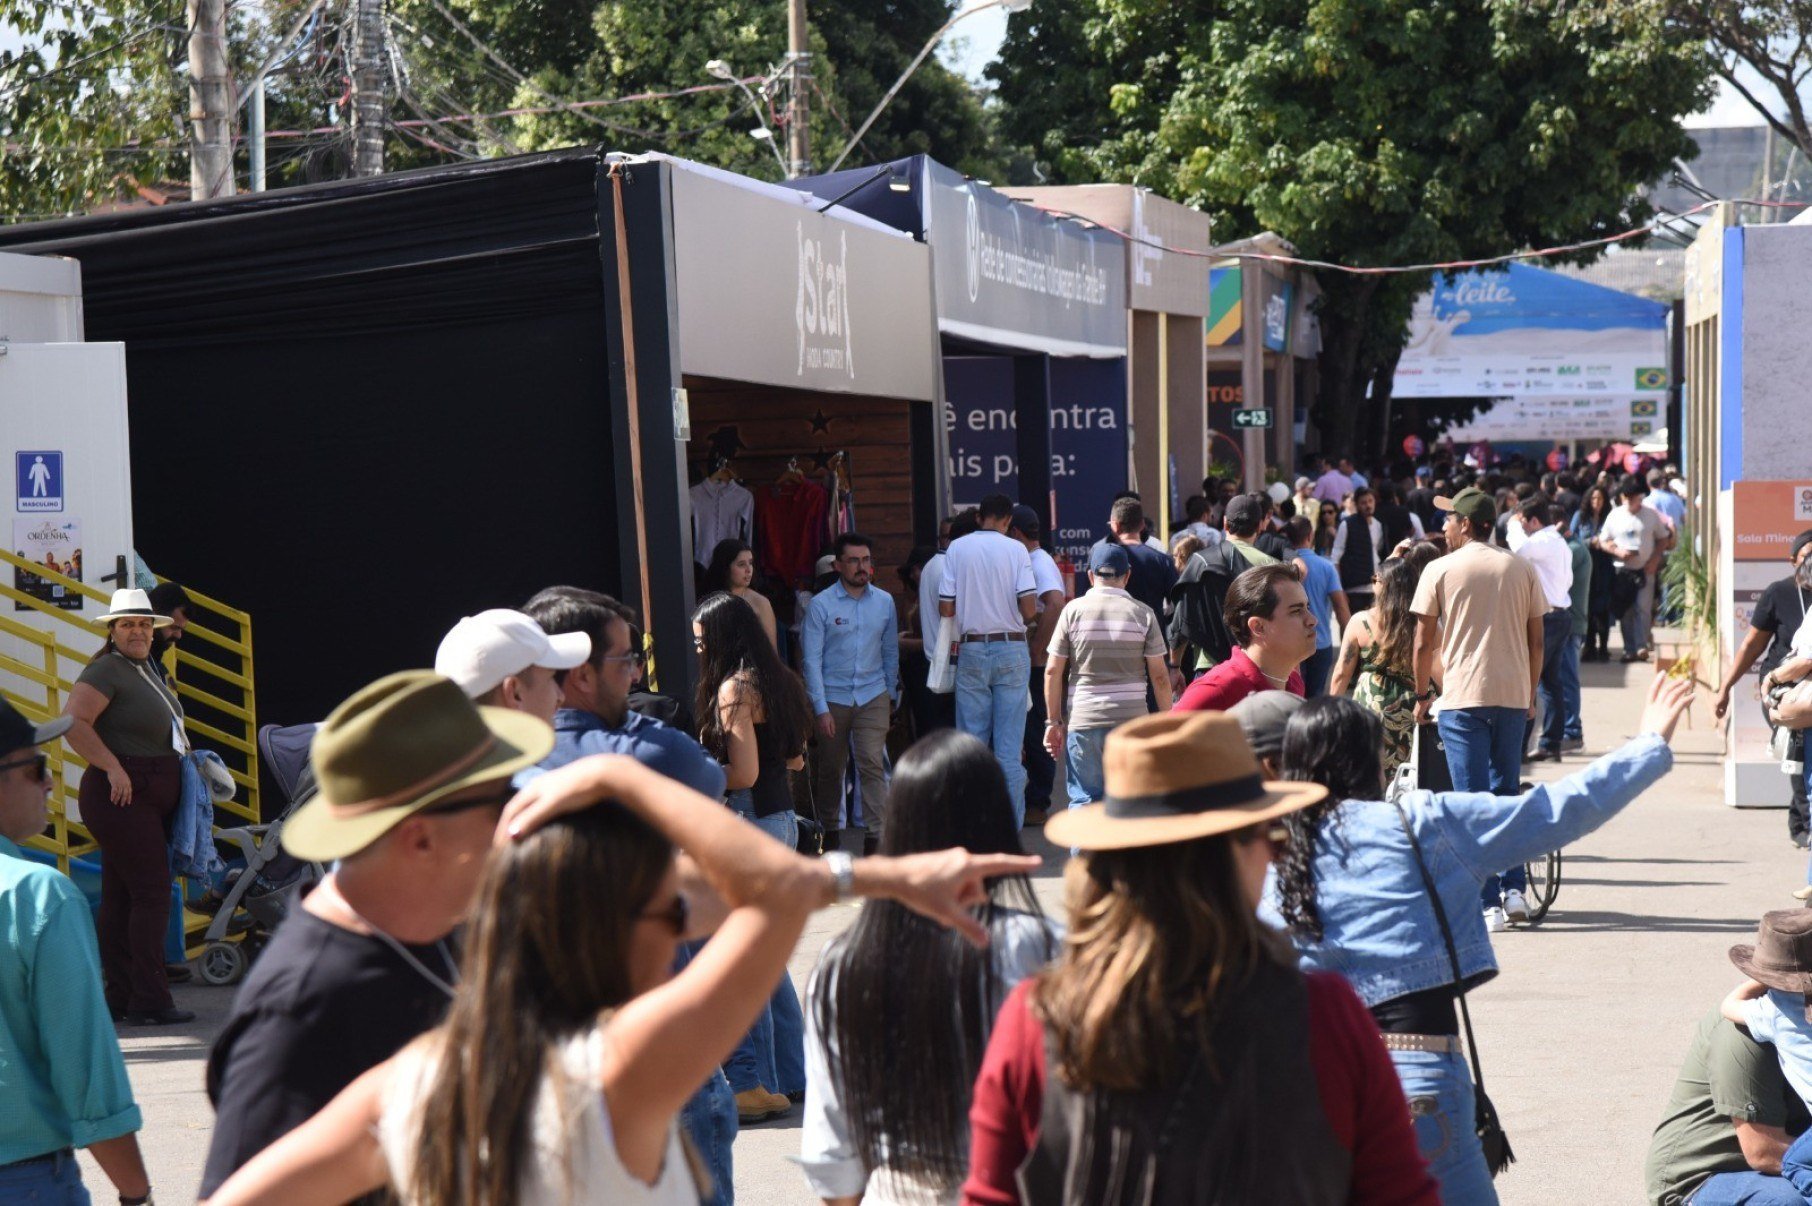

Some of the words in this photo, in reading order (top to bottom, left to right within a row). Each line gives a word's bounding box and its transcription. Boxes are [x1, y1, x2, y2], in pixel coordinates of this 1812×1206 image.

[967, 403, 1118, 431] enntra
[27, 529, 70, 541] ORDENHA
[1059, 528, 1091, 539] com
[1736, 533, 1762, 544] Sala
